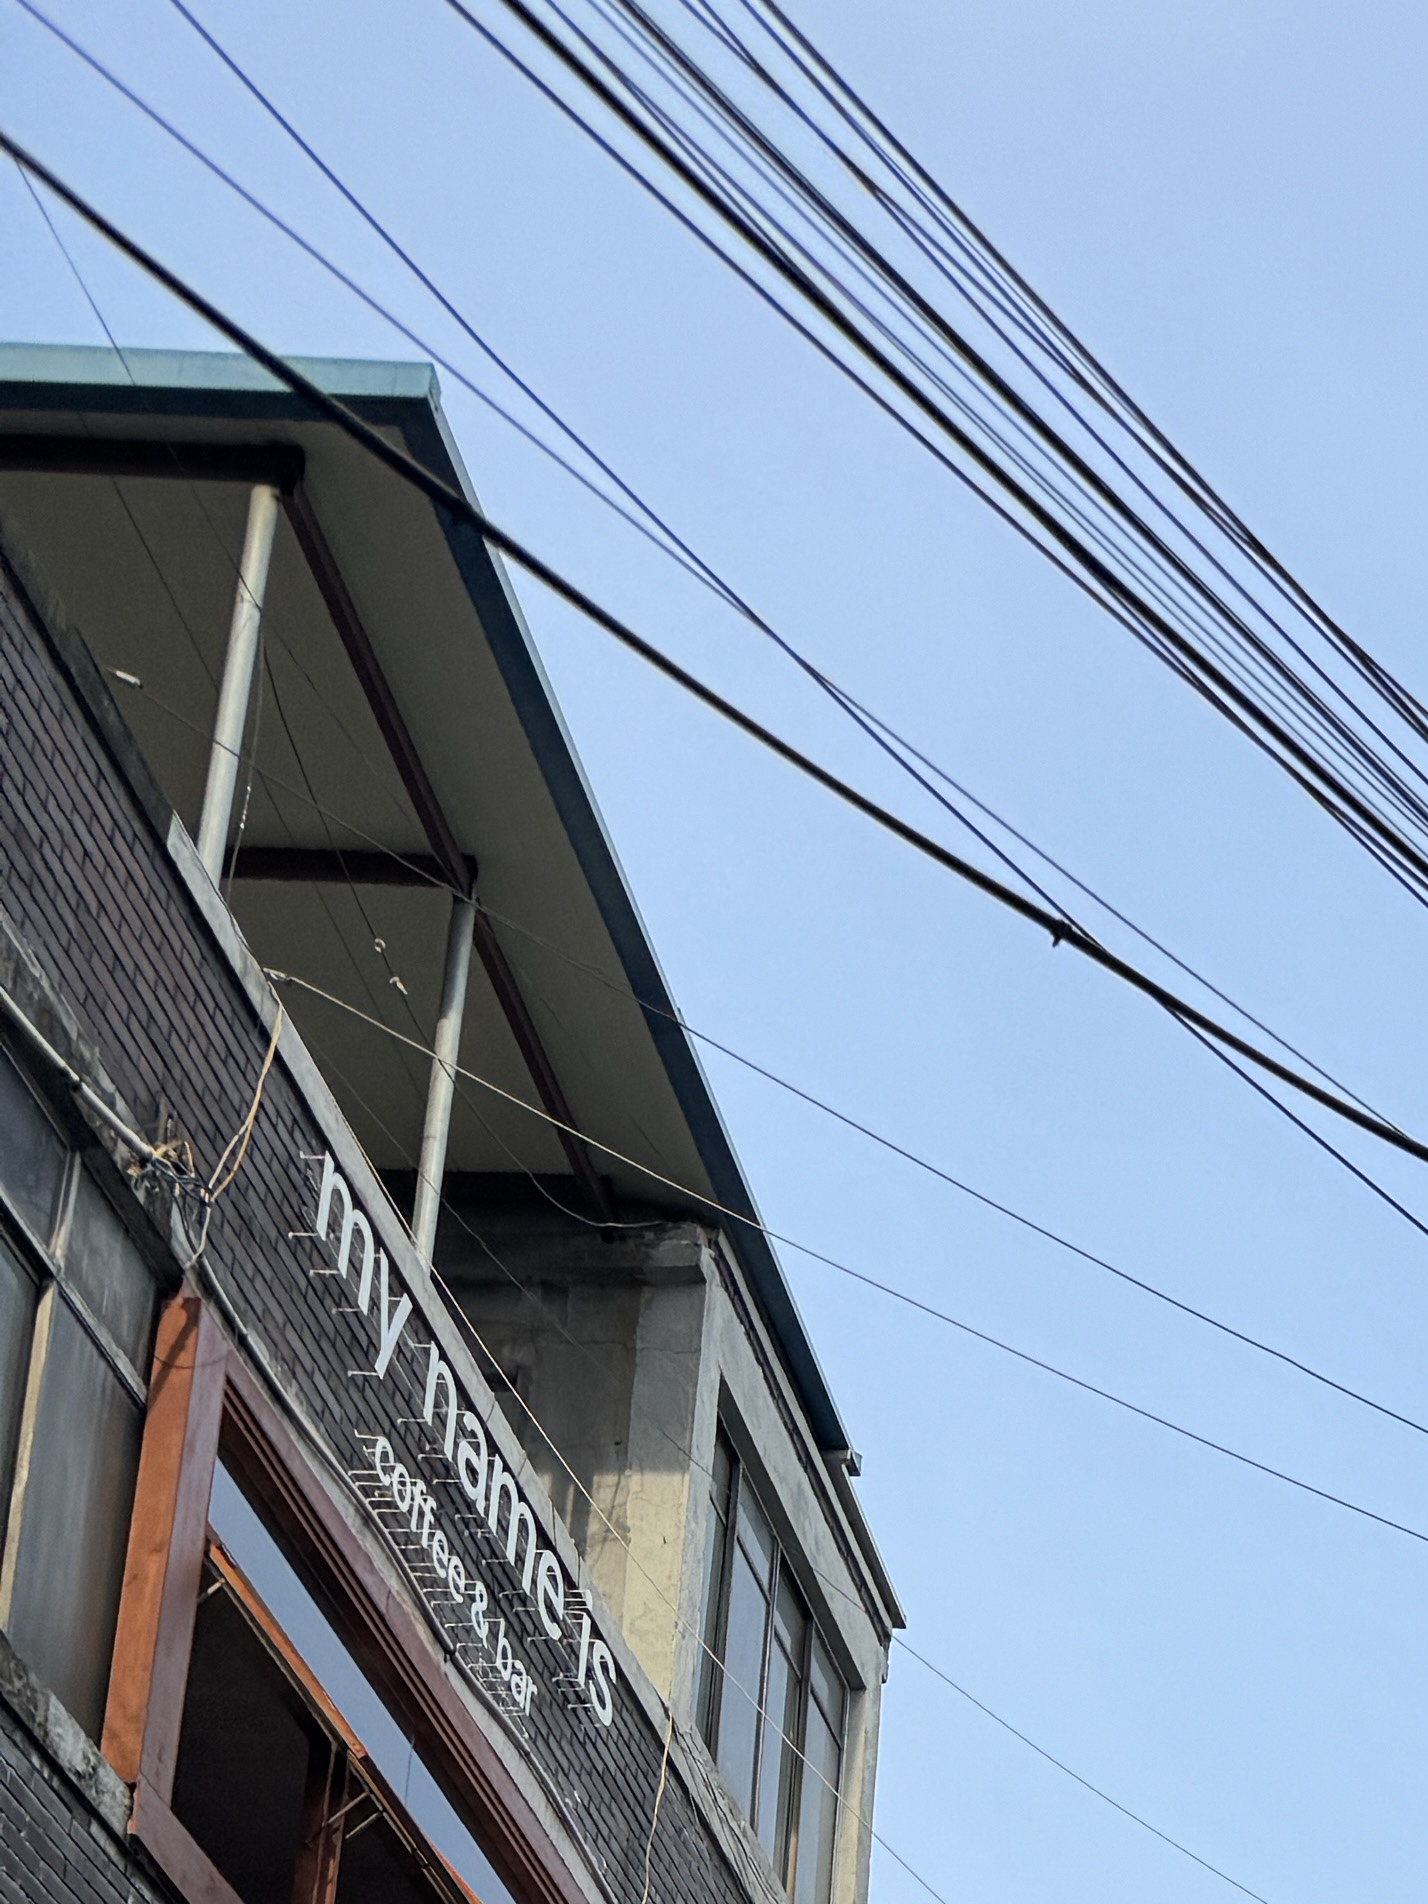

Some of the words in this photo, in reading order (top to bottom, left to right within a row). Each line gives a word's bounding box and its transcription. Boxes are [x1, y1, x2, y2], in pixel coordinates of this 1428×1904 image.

[316, 1150, 412, 1379] my
[425, 1341, 563, 1640] name
[576, 1590, 617, 1727] is
[373, 1435, 466, 1604] coffee
[470, 1582, 490, 1649] &
[495, 1618, 538, 1716] bar
